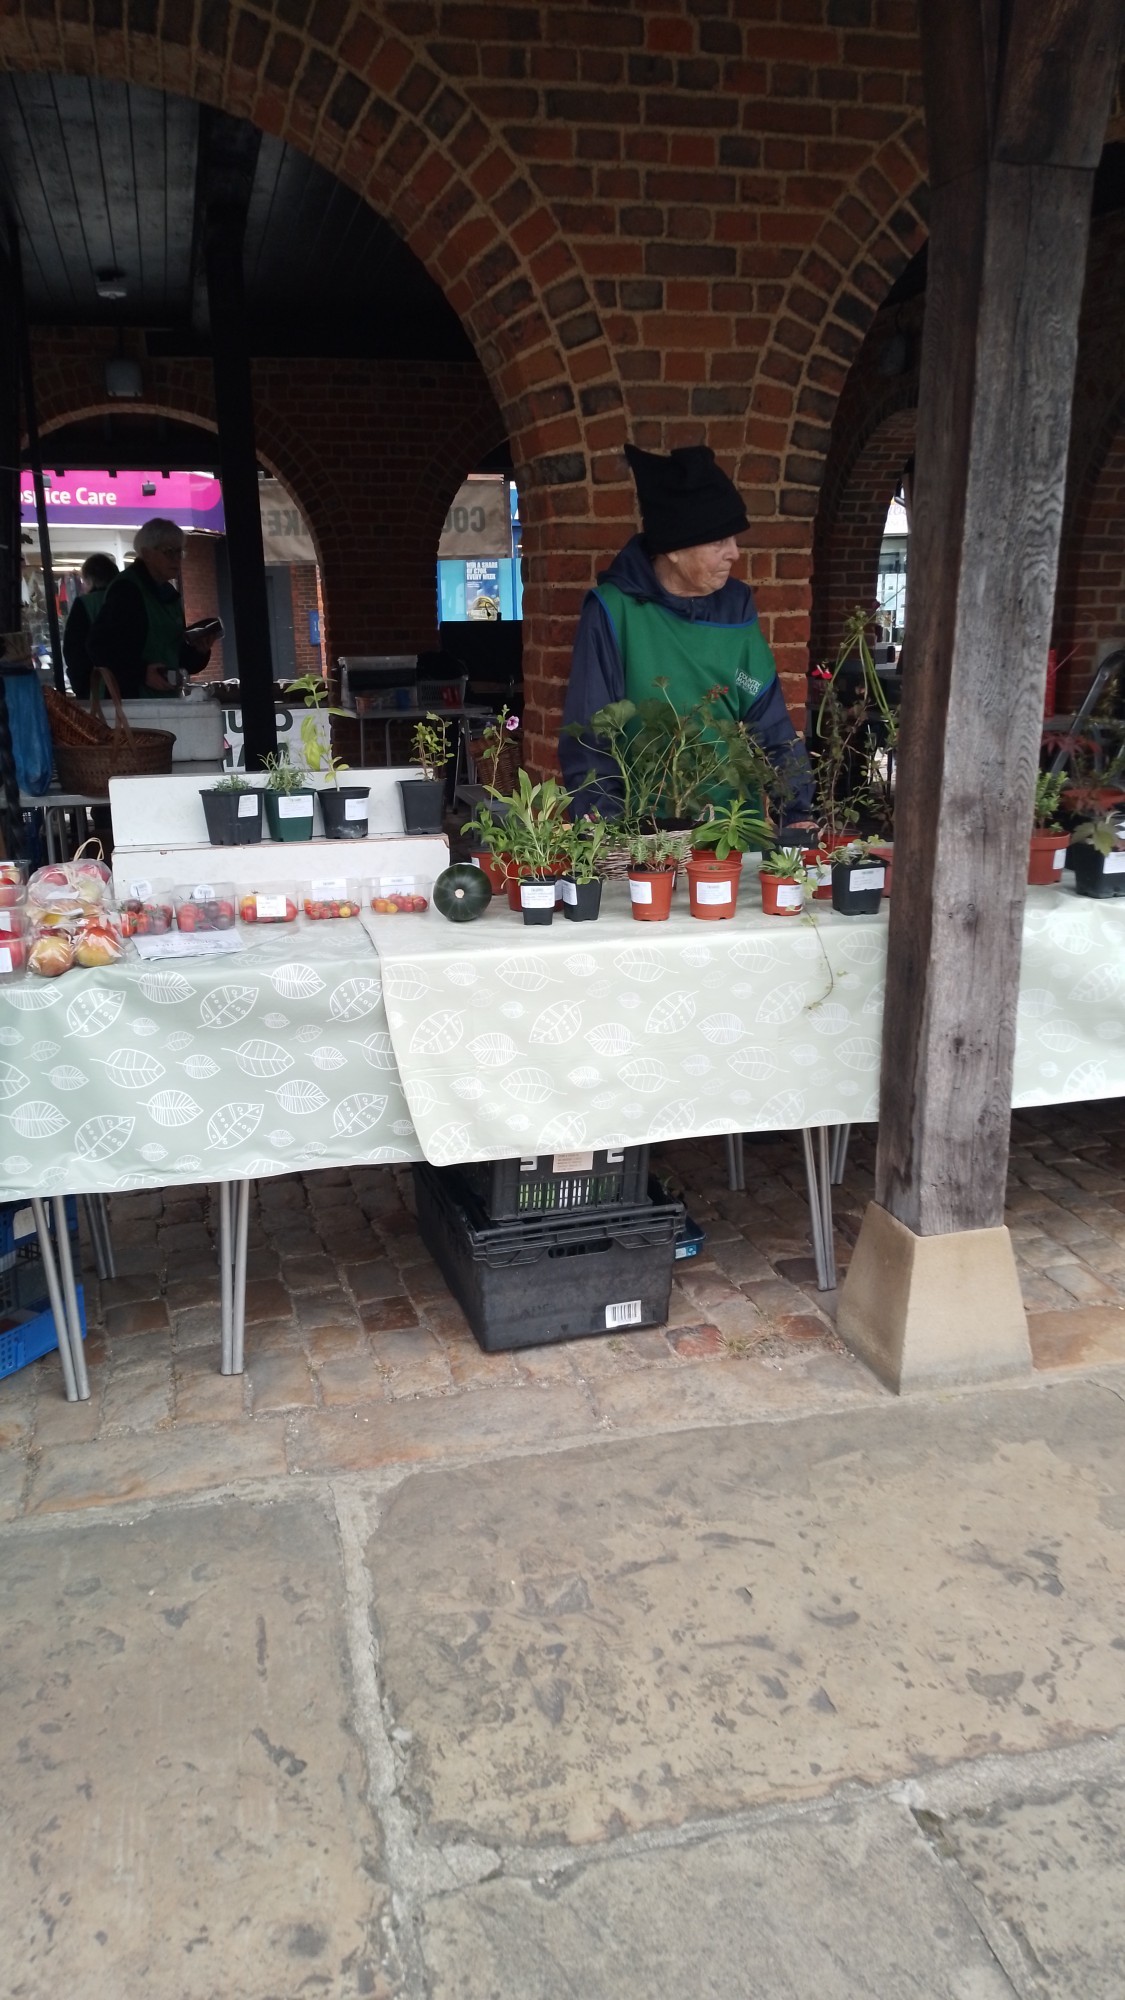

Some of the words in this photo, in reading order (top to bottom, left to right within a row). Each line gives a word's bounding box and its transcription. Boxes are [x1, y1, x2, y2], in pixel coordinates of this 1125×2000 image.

[75, 487, 117, 506] Care
[736, 677, 759, 692] MARKETS
[739, 672, 761, 688] COUNTRY
